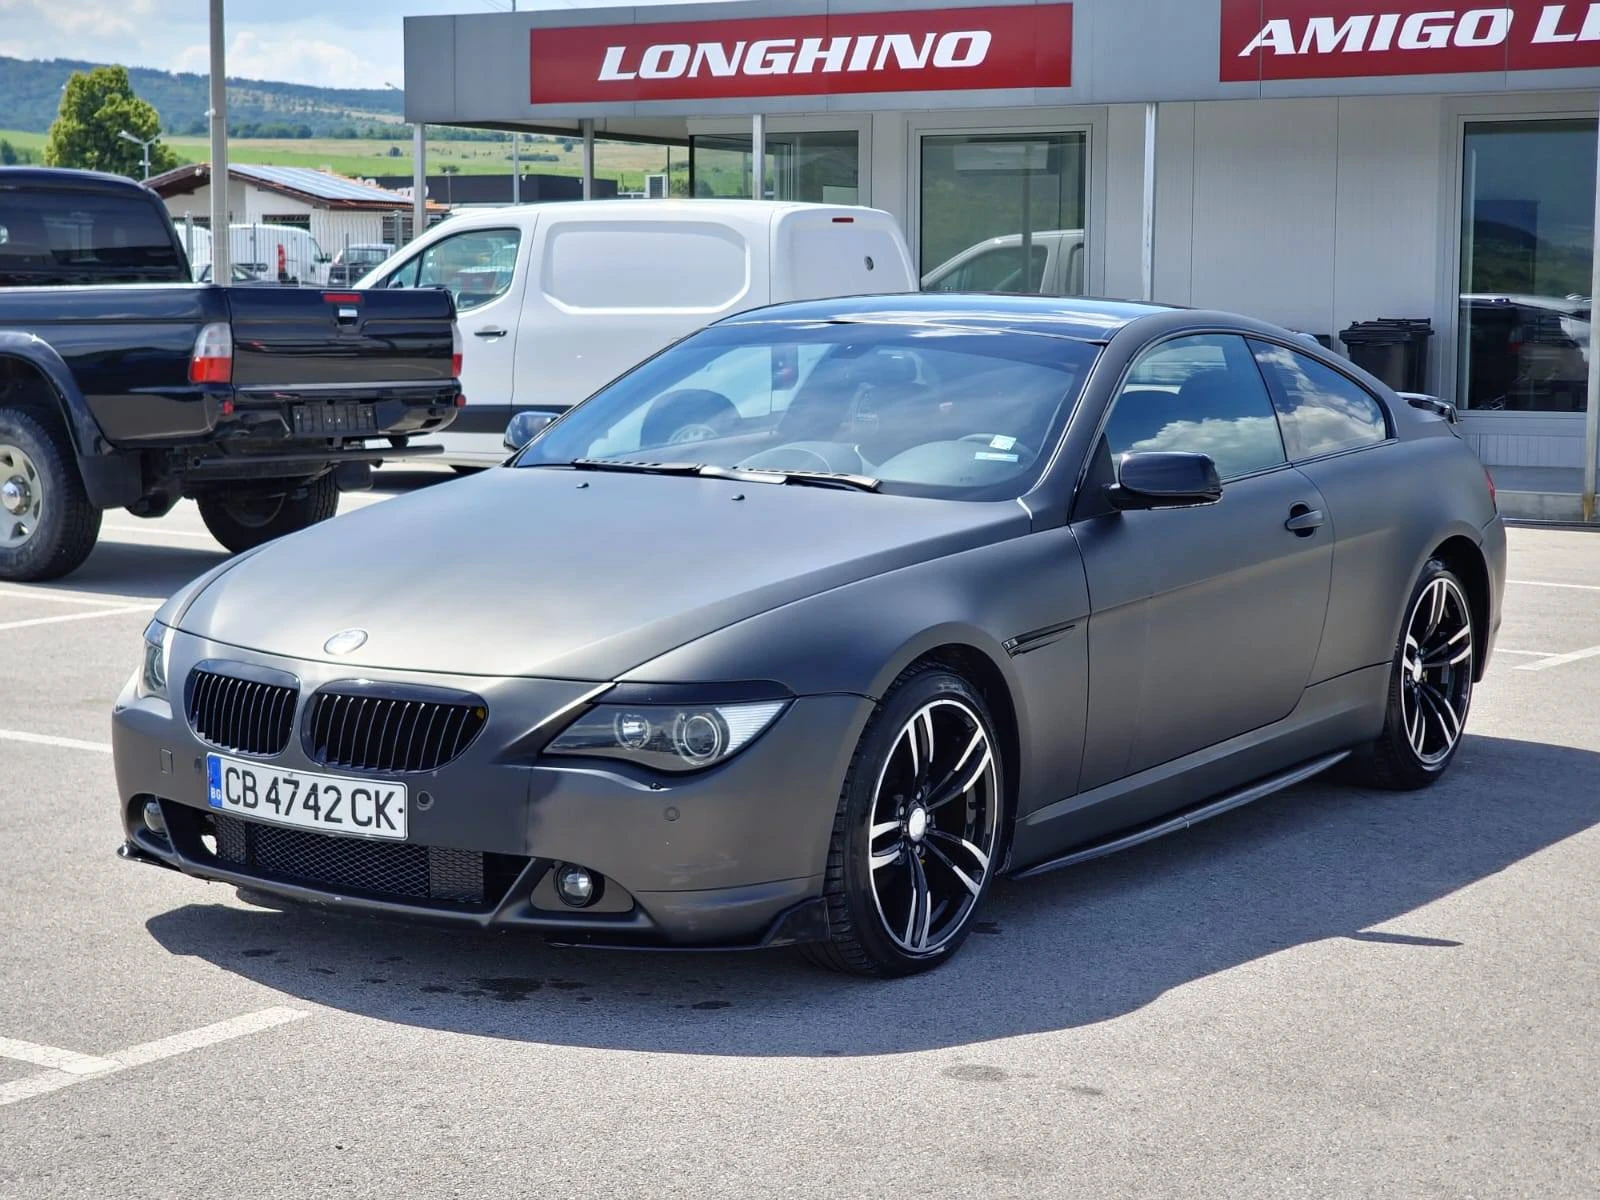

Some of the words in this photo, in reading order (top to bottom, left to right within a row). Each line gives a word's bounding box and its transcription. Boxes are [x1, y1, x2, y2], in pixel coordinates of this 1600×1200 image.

[598, 30, 992, 82] LONGHINO
[1237, 8, 1514, 57] AMIGO
[225, 766, 259, 809] CB
[265, 776, 343, 824] 4742
[351, 788, 397, 831] CK
